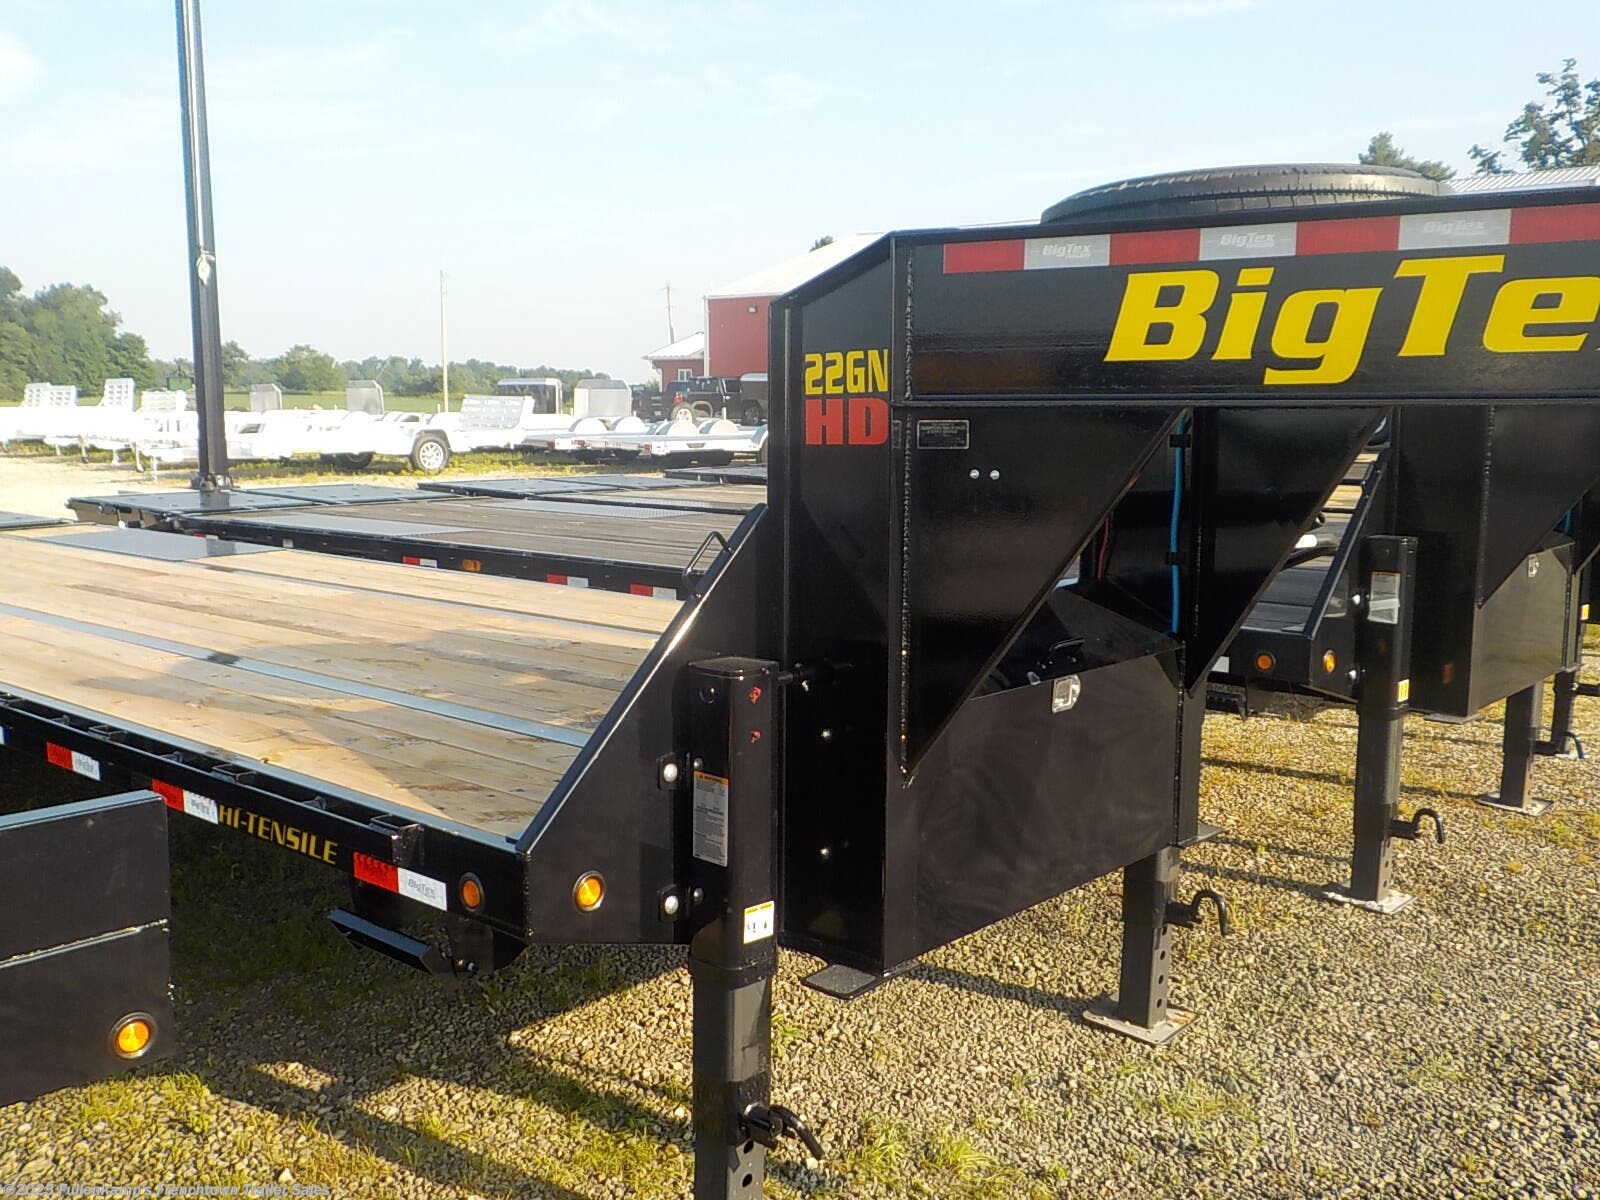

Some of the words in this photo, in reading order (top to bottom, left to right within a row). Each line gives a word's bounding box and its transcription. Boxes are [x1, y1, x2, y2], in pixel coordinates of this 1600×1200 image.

[1221, 232, 1275, 248] BigTex
[1424, 220, 1485, 237] BigTex
[1042, 243, 1092, 259] BigTex
[1104, 253, 1600, 386] BigTe
[804, 348, 889, 395] 22GN
[804, 397, 890, 446] HD
[218, 804, 339, 866] HI-TENSILE
[407, 878, 436, 897] BigTex
